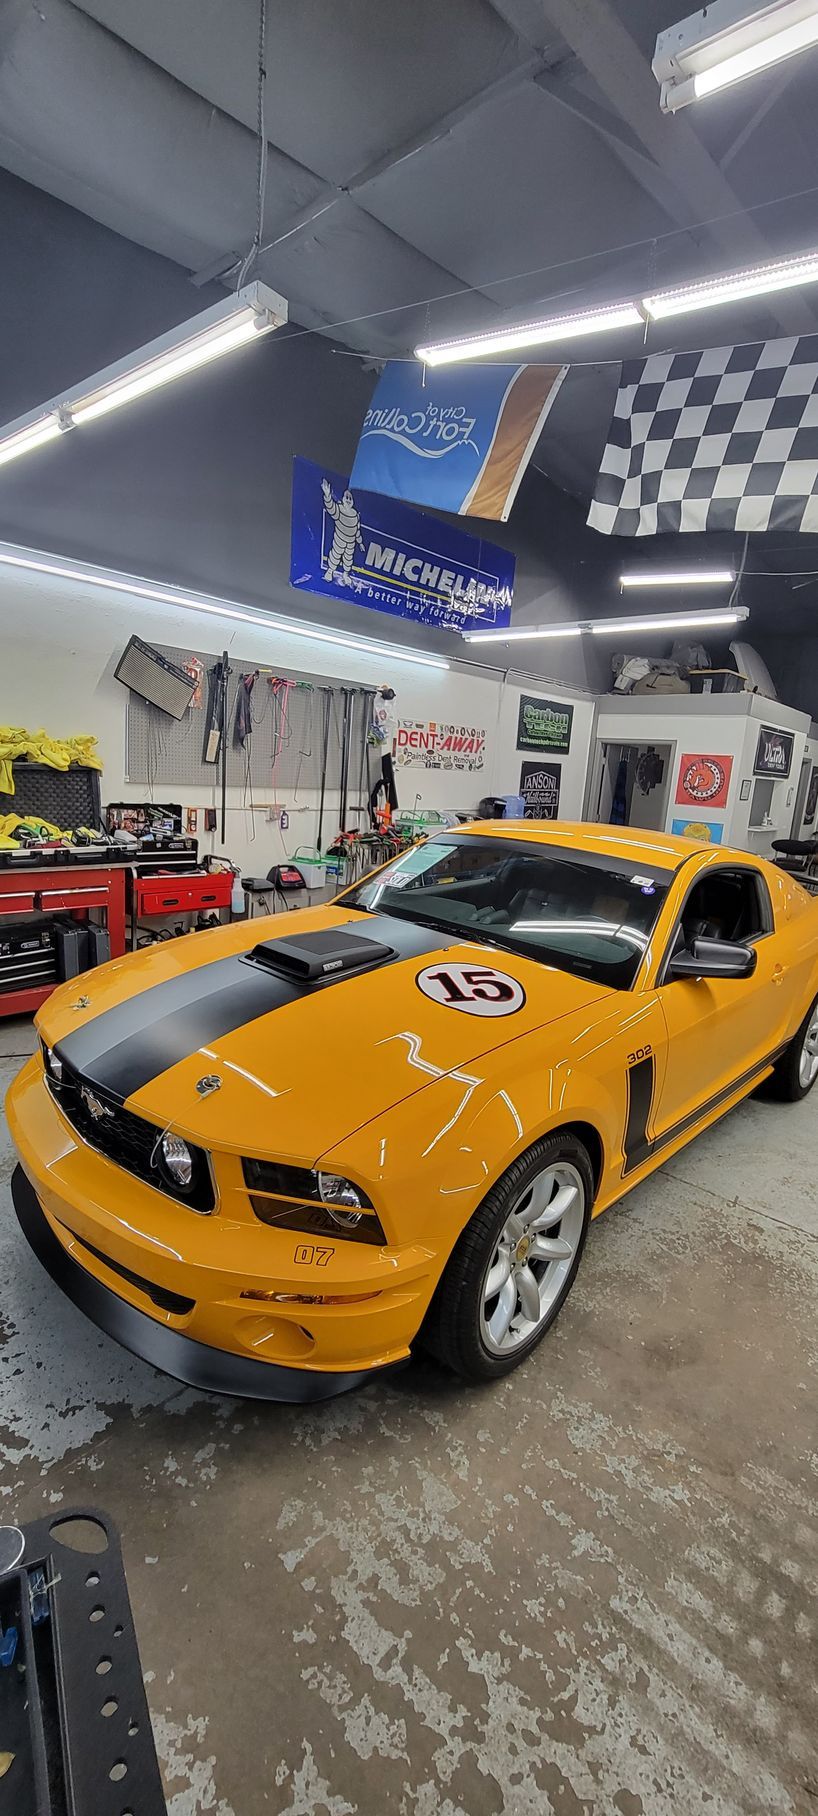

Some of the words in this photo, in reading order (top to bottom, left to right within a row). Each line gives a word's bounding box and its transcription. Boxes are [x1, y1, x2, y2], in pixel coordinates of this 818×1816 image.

[367, 587, 402, 606] better
[406, 599, 426, 615] way
[430, 604, 467, 625] forward
[523, 704, 570, 726] Carbon
[398, 729, 485, 754] DENT-AWAY
[438, 754, 452, 763] Dent
[453, 755, 477, 767] Removal
[526, 774, 556, 790] ANSON
[427, 970, 516, 1003] 15
[627, 1044, 653, 1065] 302
[293, 1244, 336, 1267] 07
